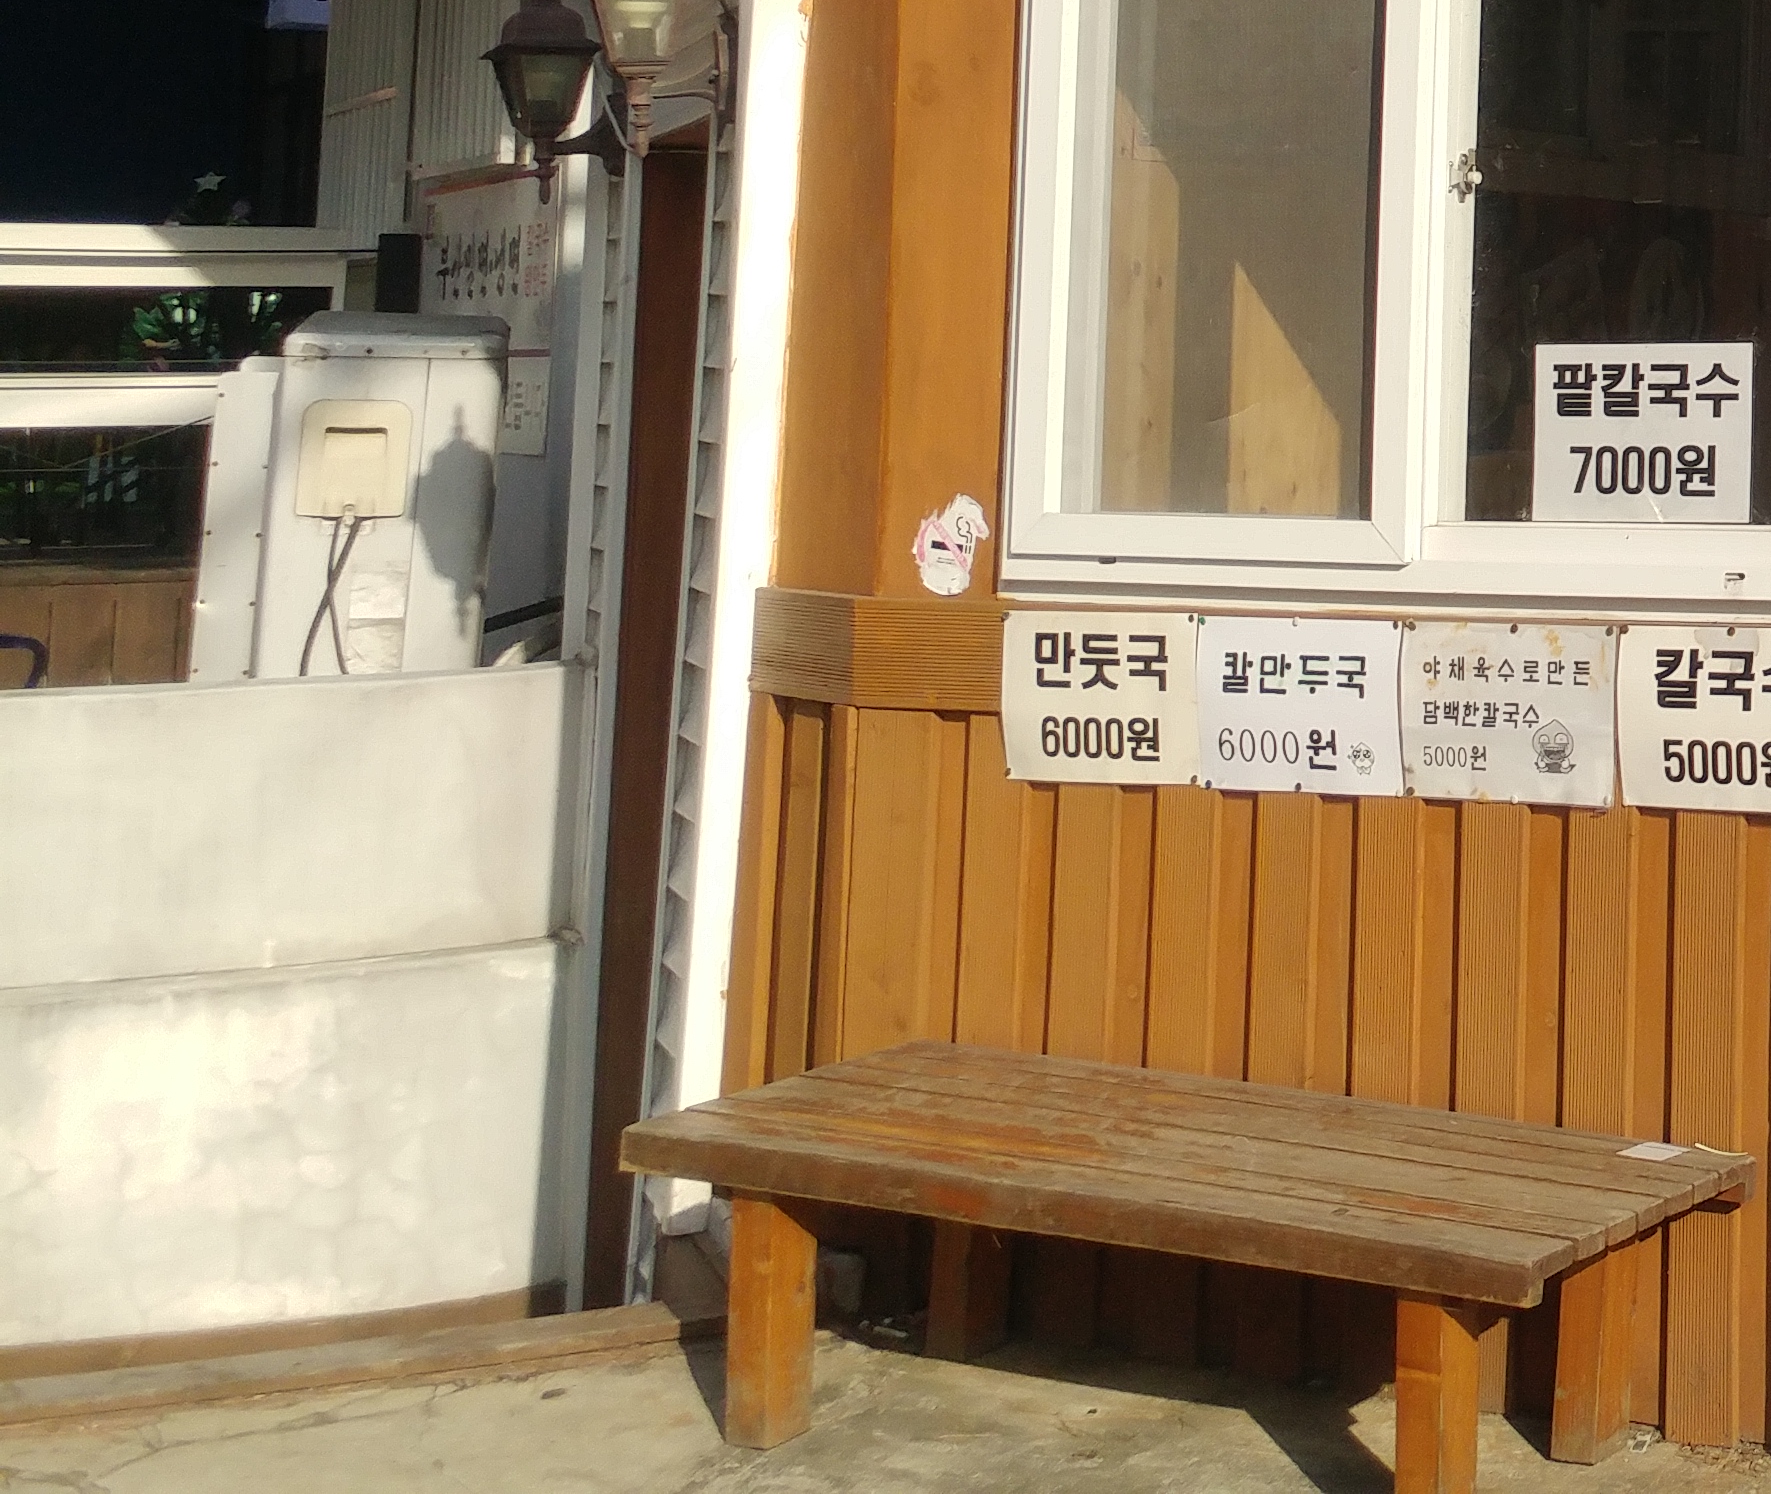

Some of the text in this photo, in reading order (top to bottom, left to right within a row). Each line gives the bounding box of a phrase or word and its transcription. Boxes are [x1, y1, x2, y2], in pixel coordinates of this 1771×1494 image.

[1553, 362, 1741, 418] 팥칼국수
[1569, 444, 1717, 497] 7000원
[1034, 631, 1168, 692] 만둣국
[1222, 651, 1367, 699] 칼만두국
[1041, 716, 1161, 762] 6000원
[1218, 728, 1338, 771] 6000원
[1423, 745, 1487, 772] 5000원
